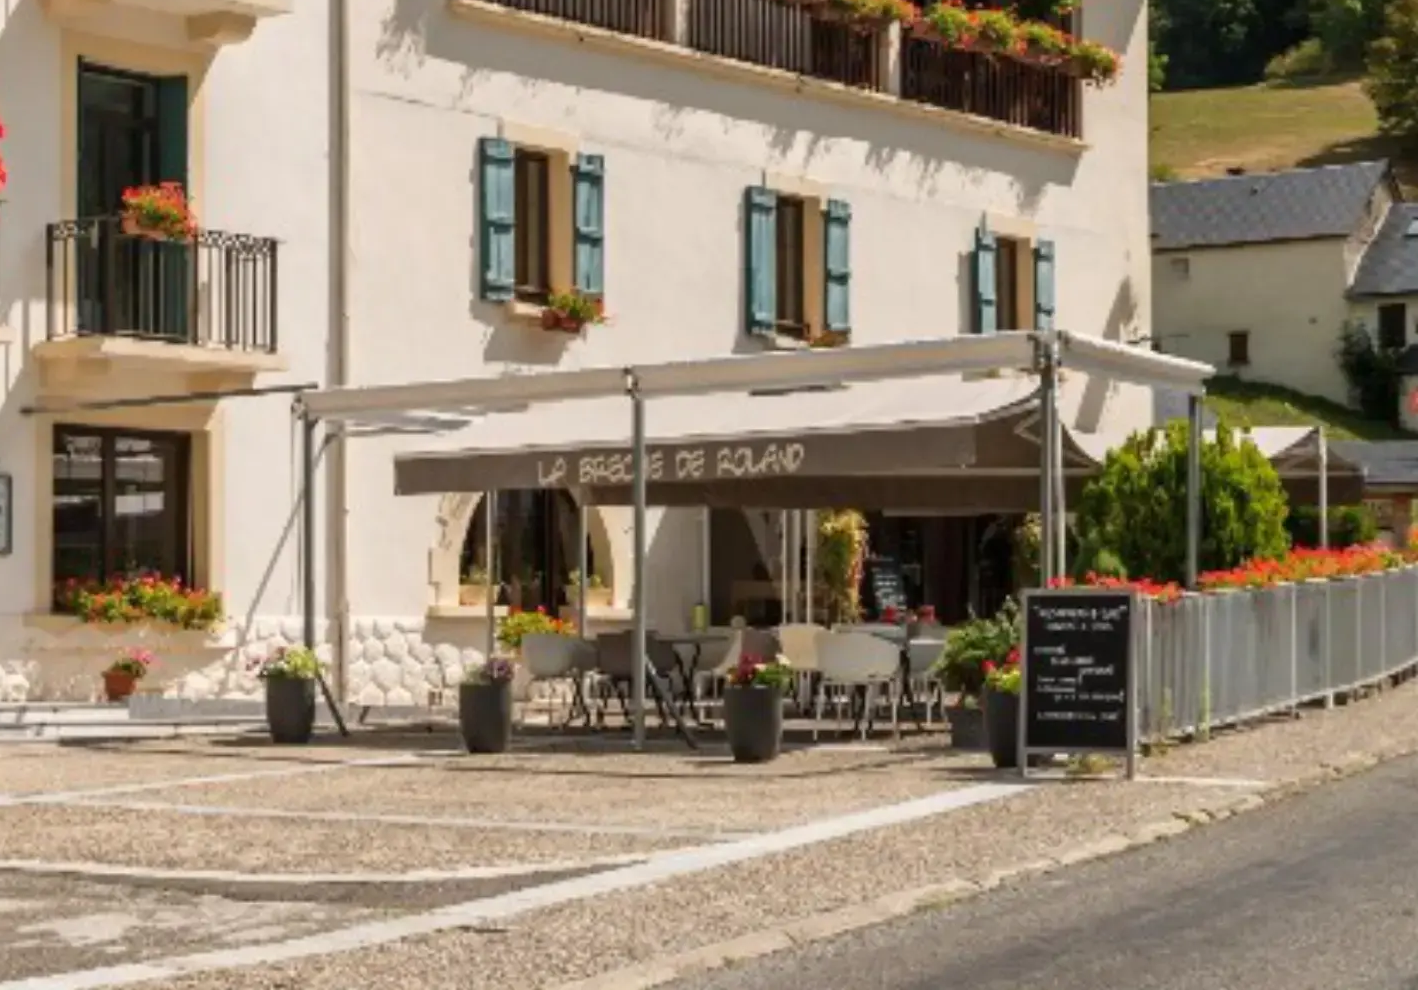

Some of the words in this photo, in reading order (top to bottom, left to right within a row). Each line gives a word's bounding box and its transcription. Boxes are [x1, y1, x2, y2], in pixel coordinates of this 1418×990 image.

[537, 457, 567, 486] LA
[579, 450, 663, 484] BRECE
[675, 450, 705, 478] DE
[717, 443, 804, 476] ROLAND
